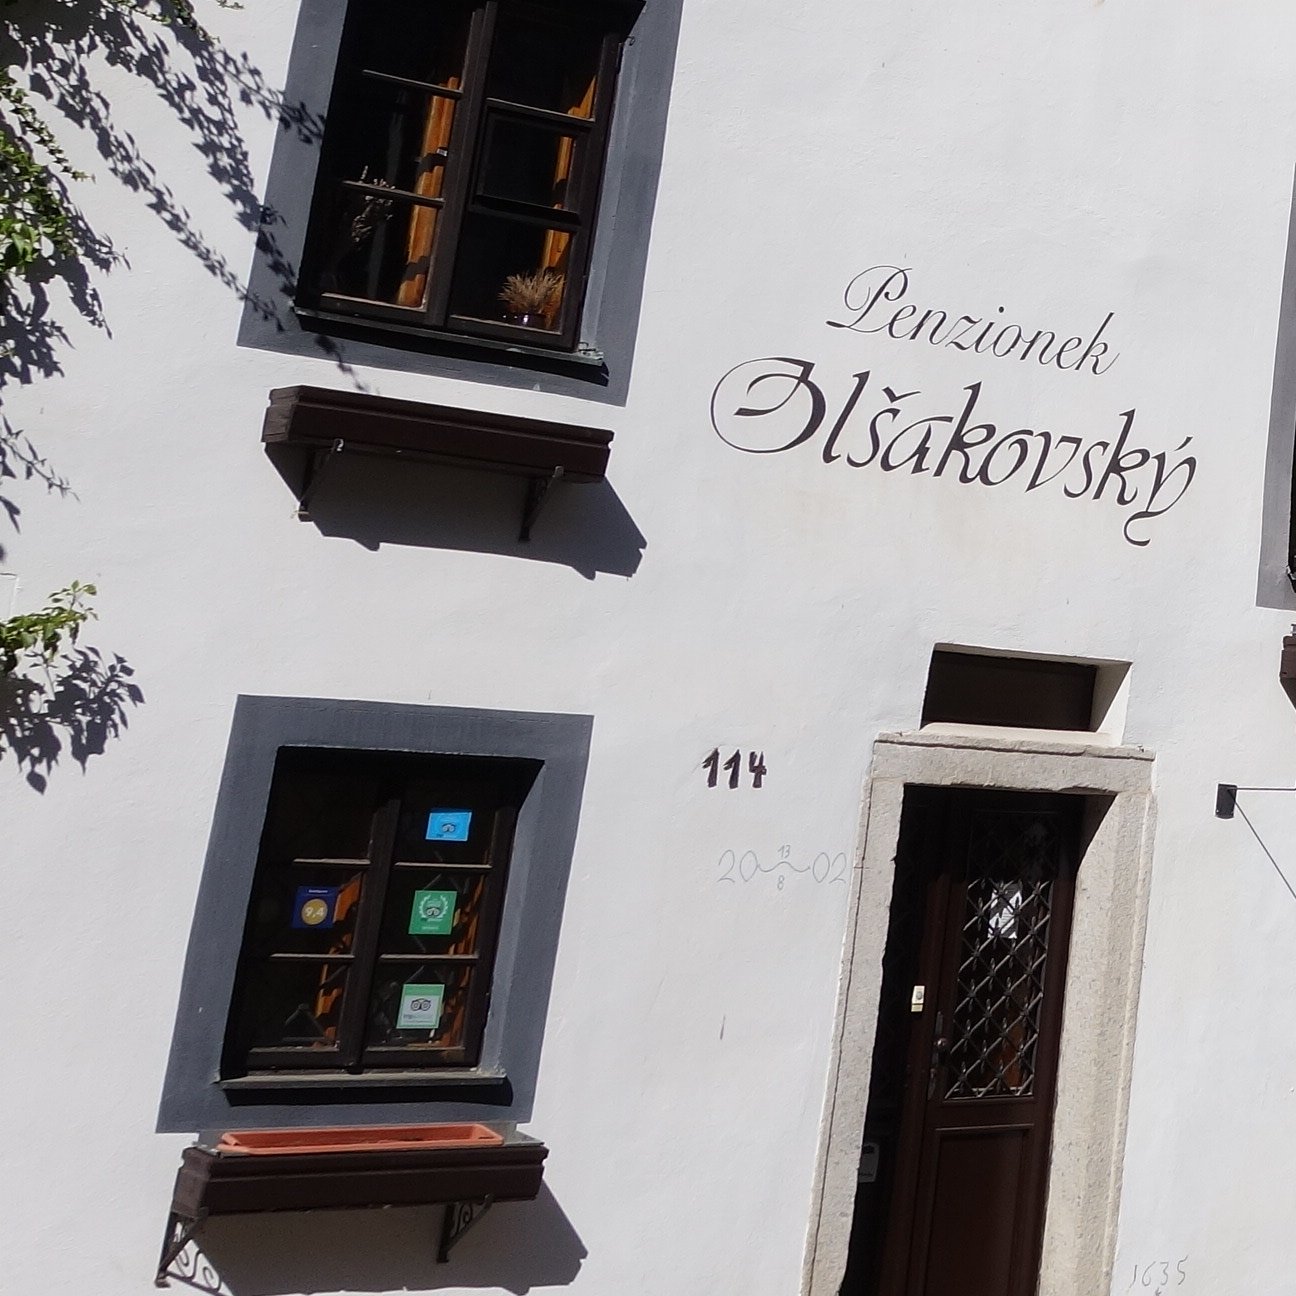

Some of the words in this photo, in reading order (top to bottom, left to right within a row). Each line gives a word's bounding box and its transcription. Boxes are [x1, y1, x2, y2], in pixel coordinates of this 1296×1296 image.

[826, 265, 1120, 375] Penzionek
[710, 356, 1198, 547] Olšakovský
[702, 747, 767, 789] 114
[304, 906, 325, 918] 9,4
[1128, 1254, 1190, 1289] 1635
